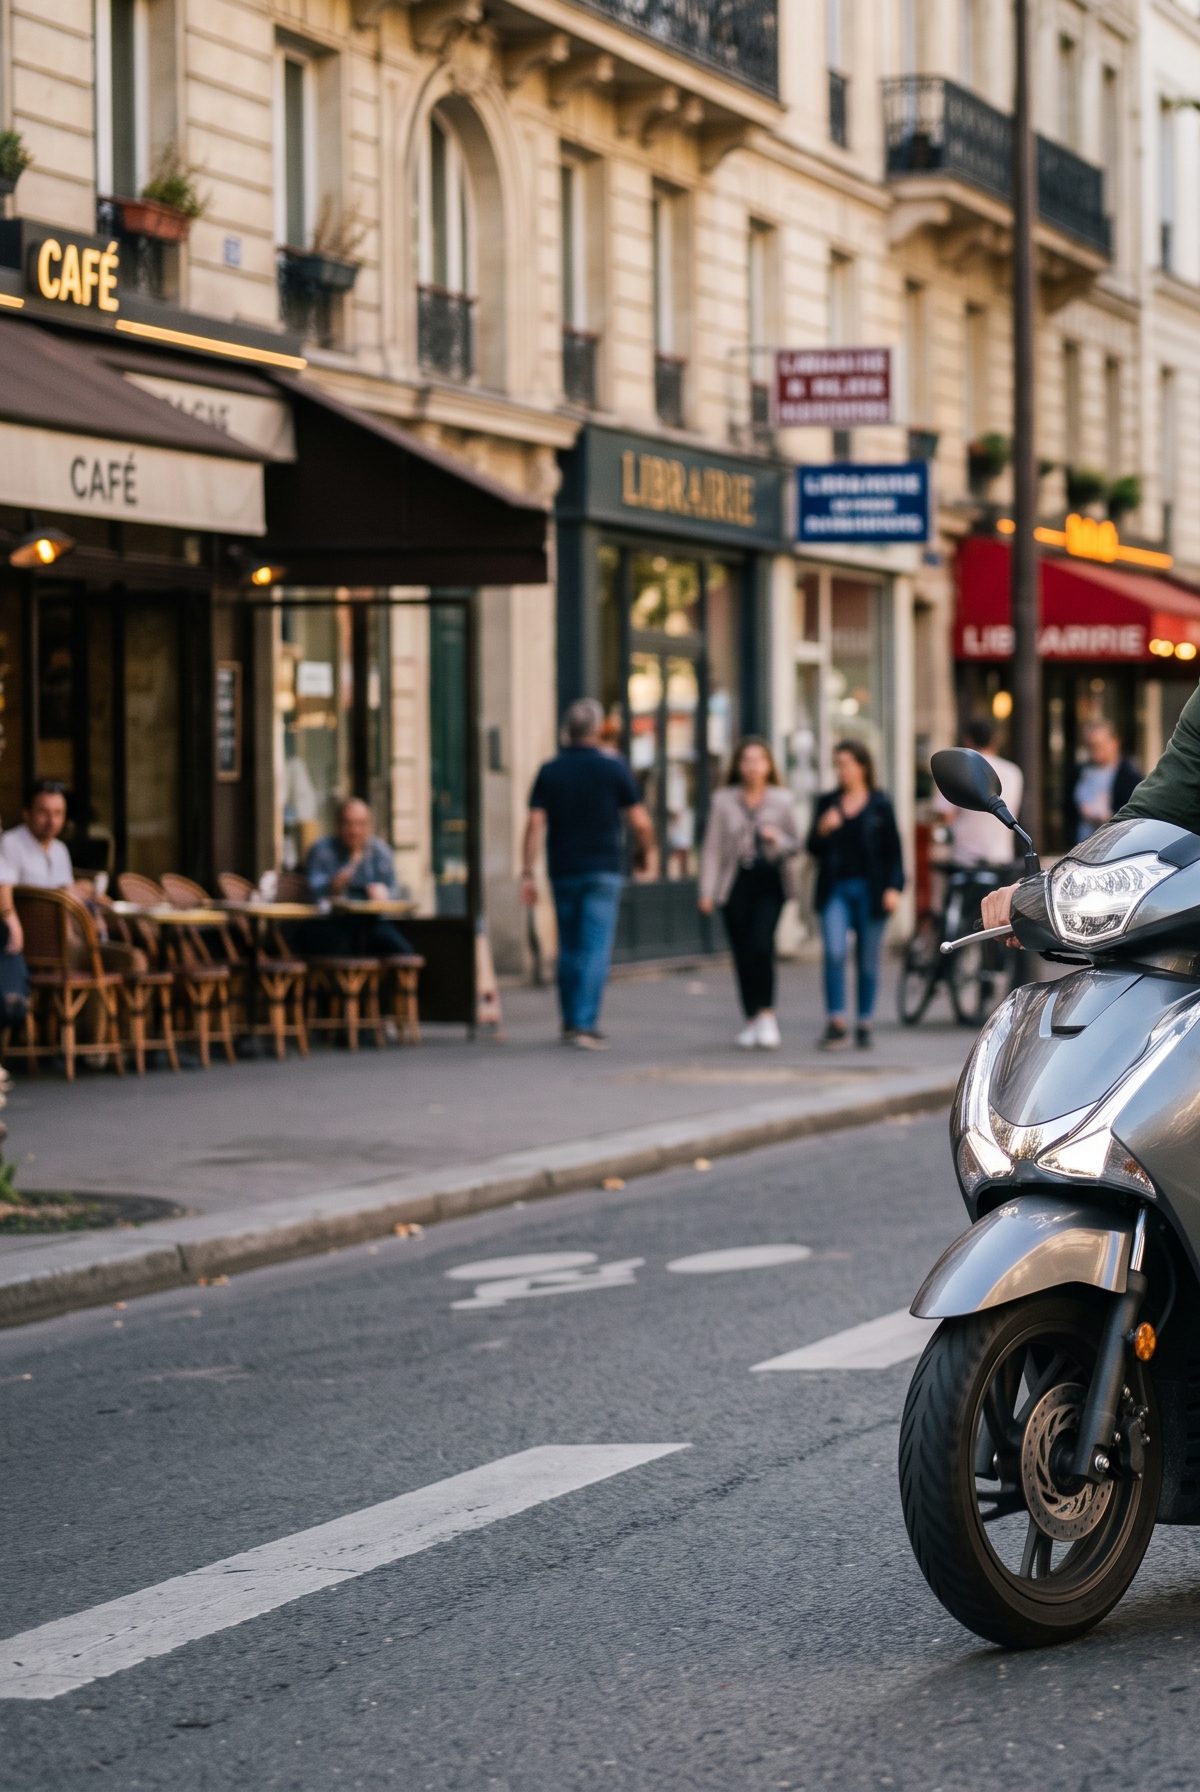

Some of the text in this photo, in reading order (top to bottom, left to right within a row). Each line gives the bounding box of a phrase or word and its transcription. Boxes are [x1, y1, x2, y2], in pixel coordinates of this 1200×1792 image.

[38, 238, 119, 312] CAFÉ
[70, 453, 137, 505] CAFÉ
[622, 449, 757, 528] LIBRAIRIE
